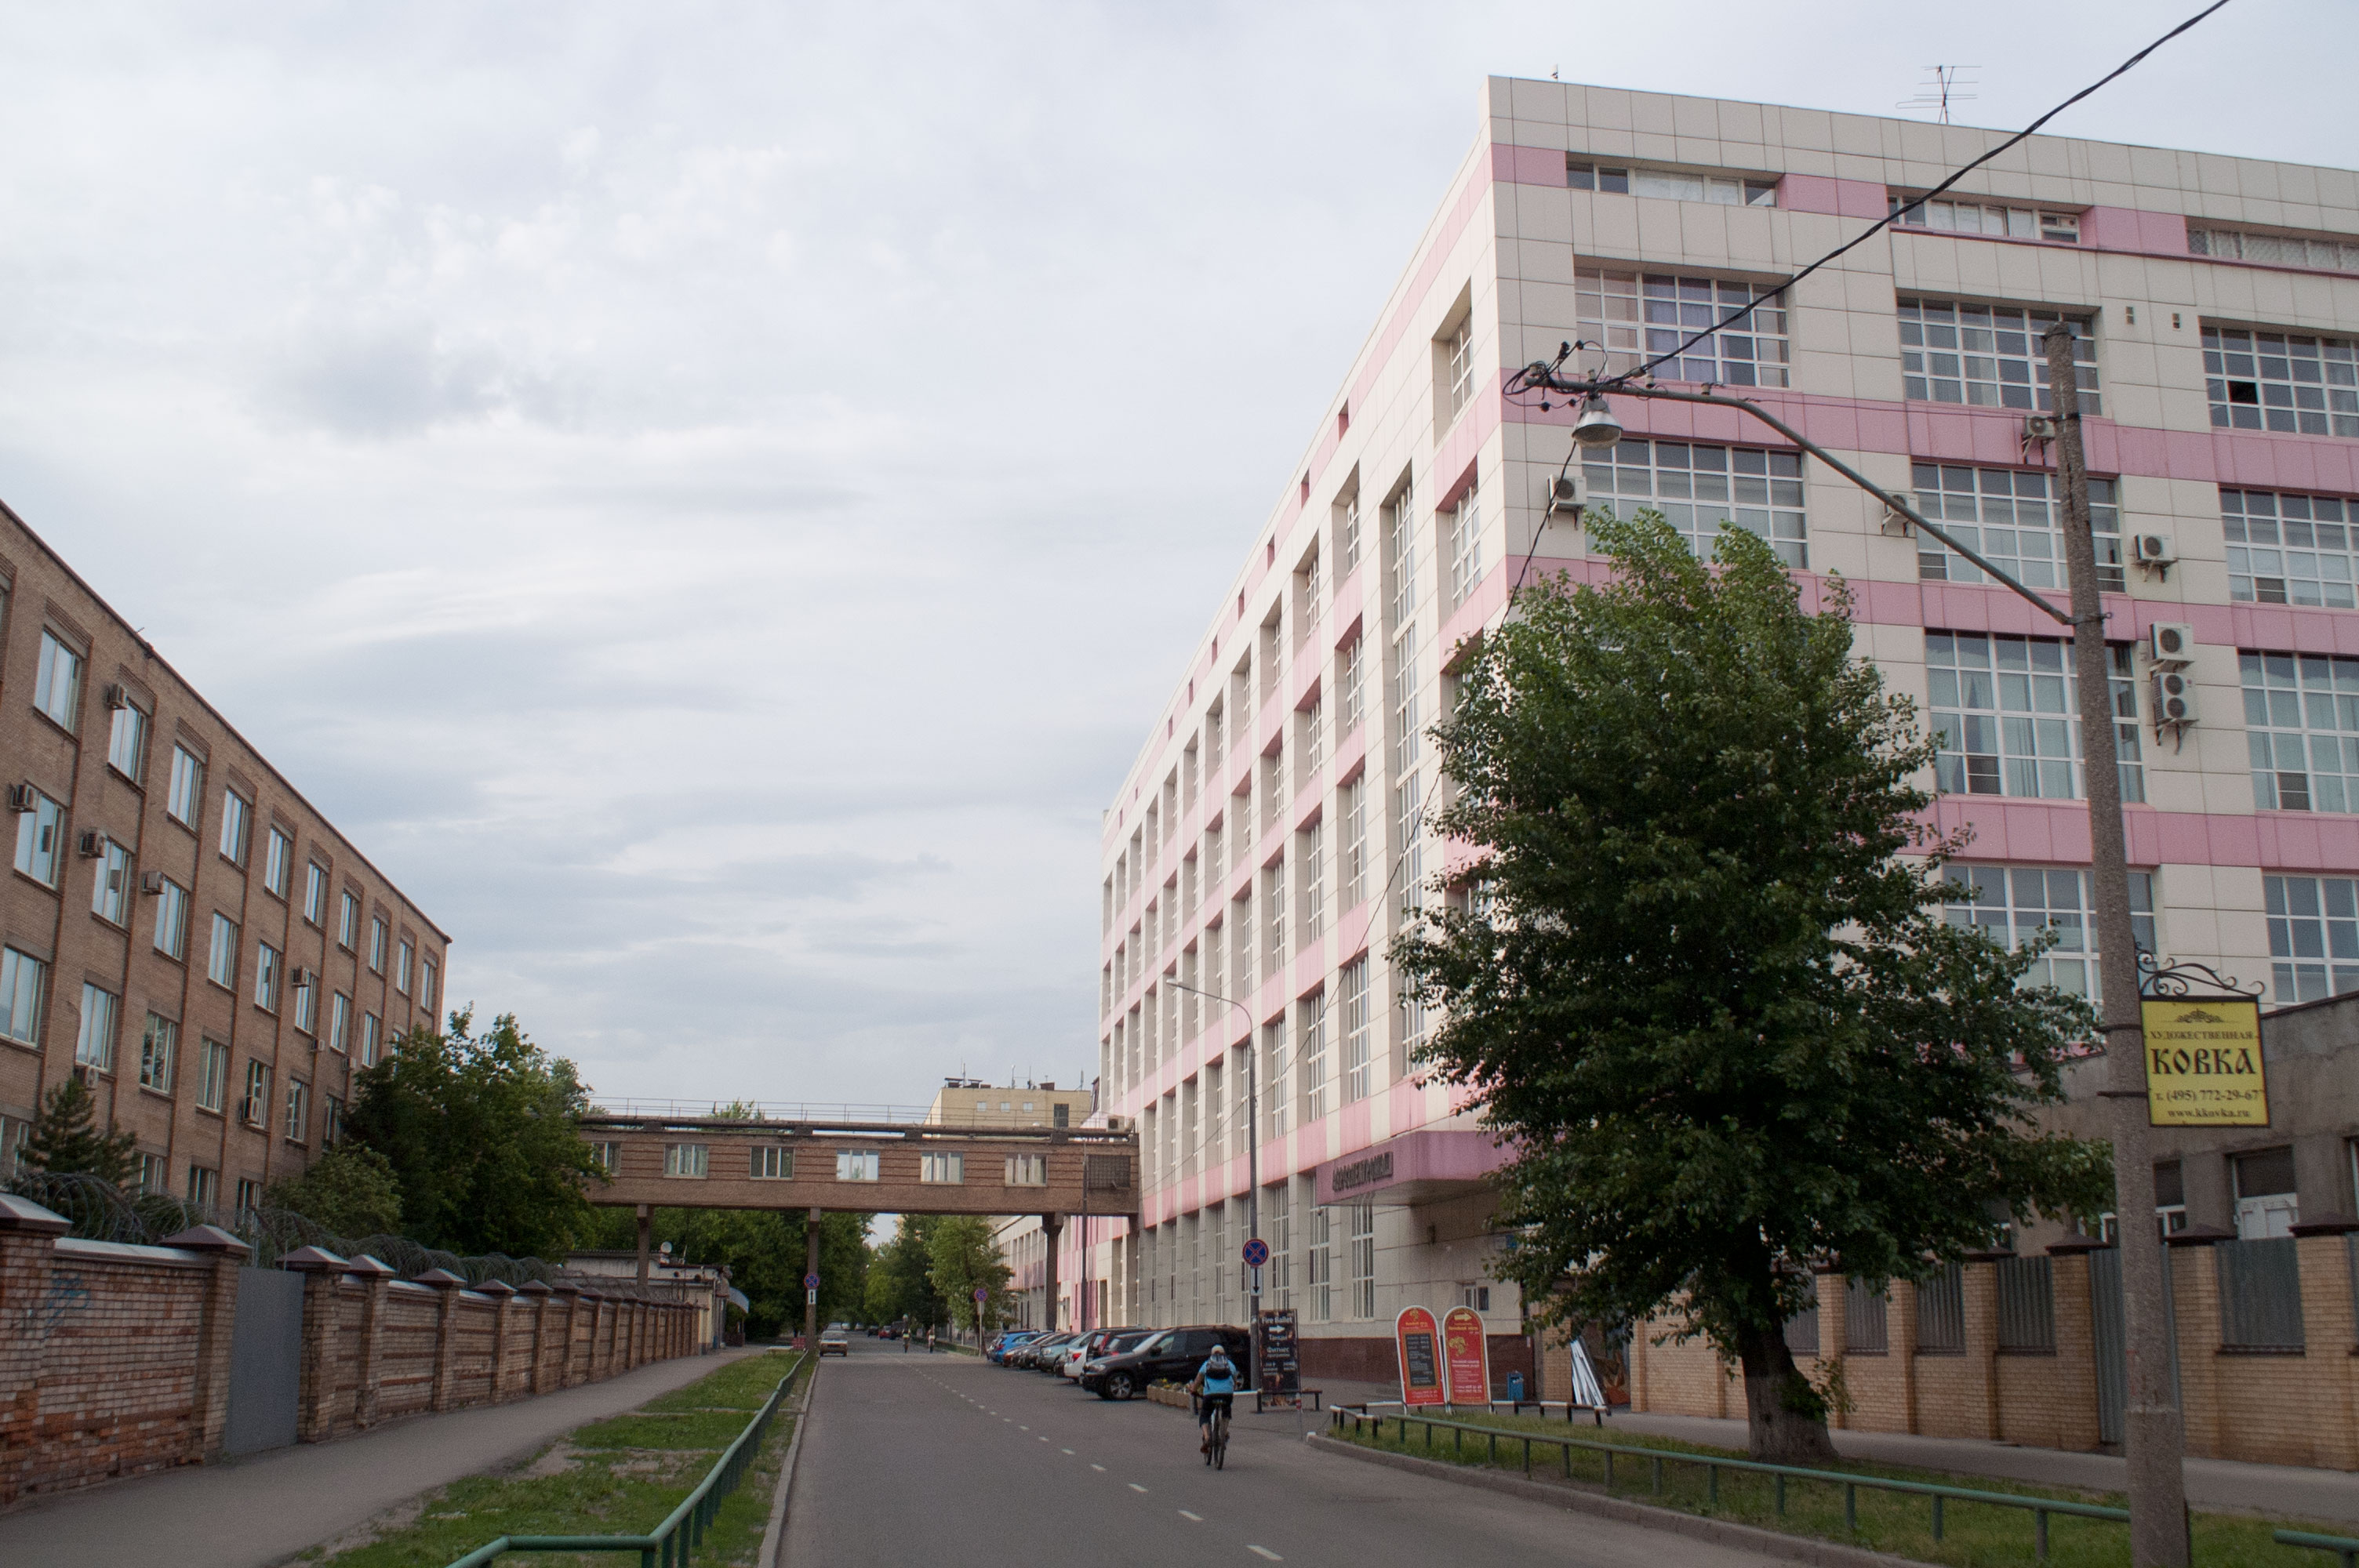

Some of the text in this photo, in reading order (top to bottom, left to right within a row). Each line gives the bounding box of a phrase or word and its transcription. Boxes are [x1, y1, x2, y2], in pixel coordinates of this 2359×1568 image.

[2151, 1048, 2255, 1074] КОВКА
[2166, 1090, 2197, 1102] (495)
[2200, 1090, 2259, 1100] 772-29-67
[2168, 1108, 2250, 1117] www.kkovka.ru
